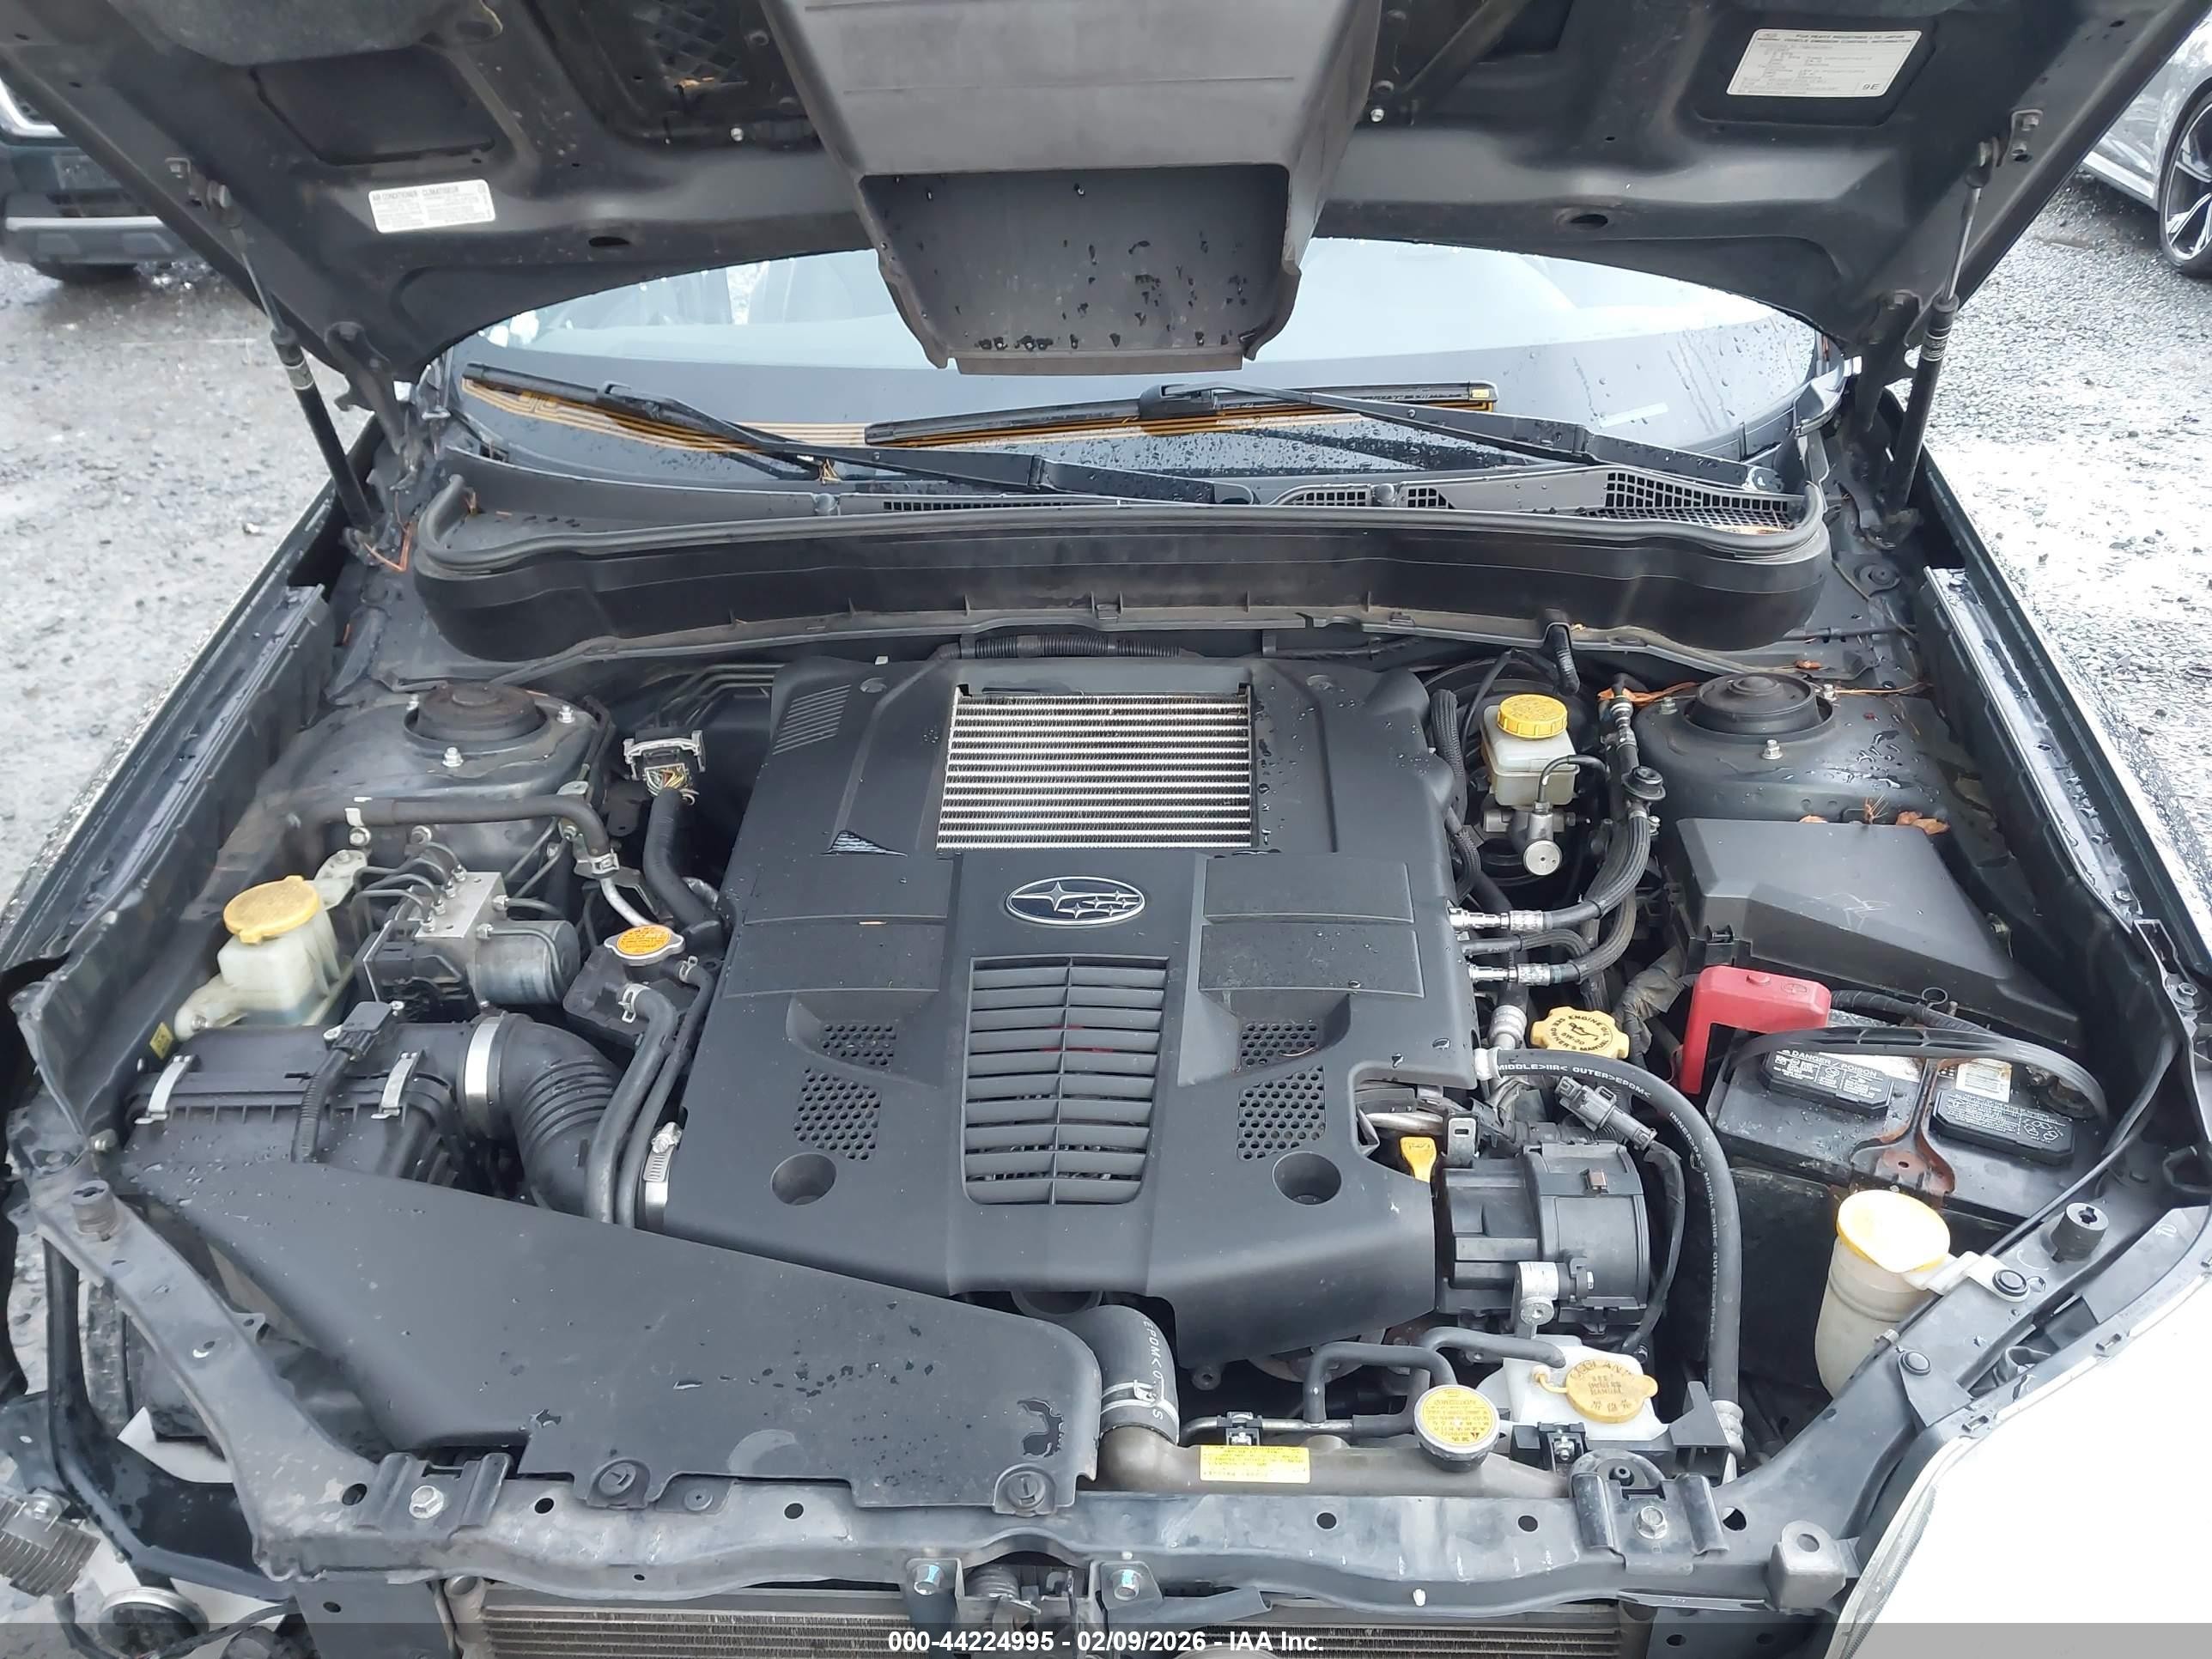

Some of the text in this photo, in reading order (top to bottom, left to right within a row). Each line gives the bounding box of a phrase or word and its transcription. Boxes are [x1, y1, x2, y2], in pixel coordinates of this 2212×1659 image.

[1552, 1018, 1565, 1027] SEE
[1568, 1015, 1610, 1036] ENGINE OIL
[1791, 1050, 1831, 1065] DANGER
[1840, 1064, 1877, 1078] POISON
